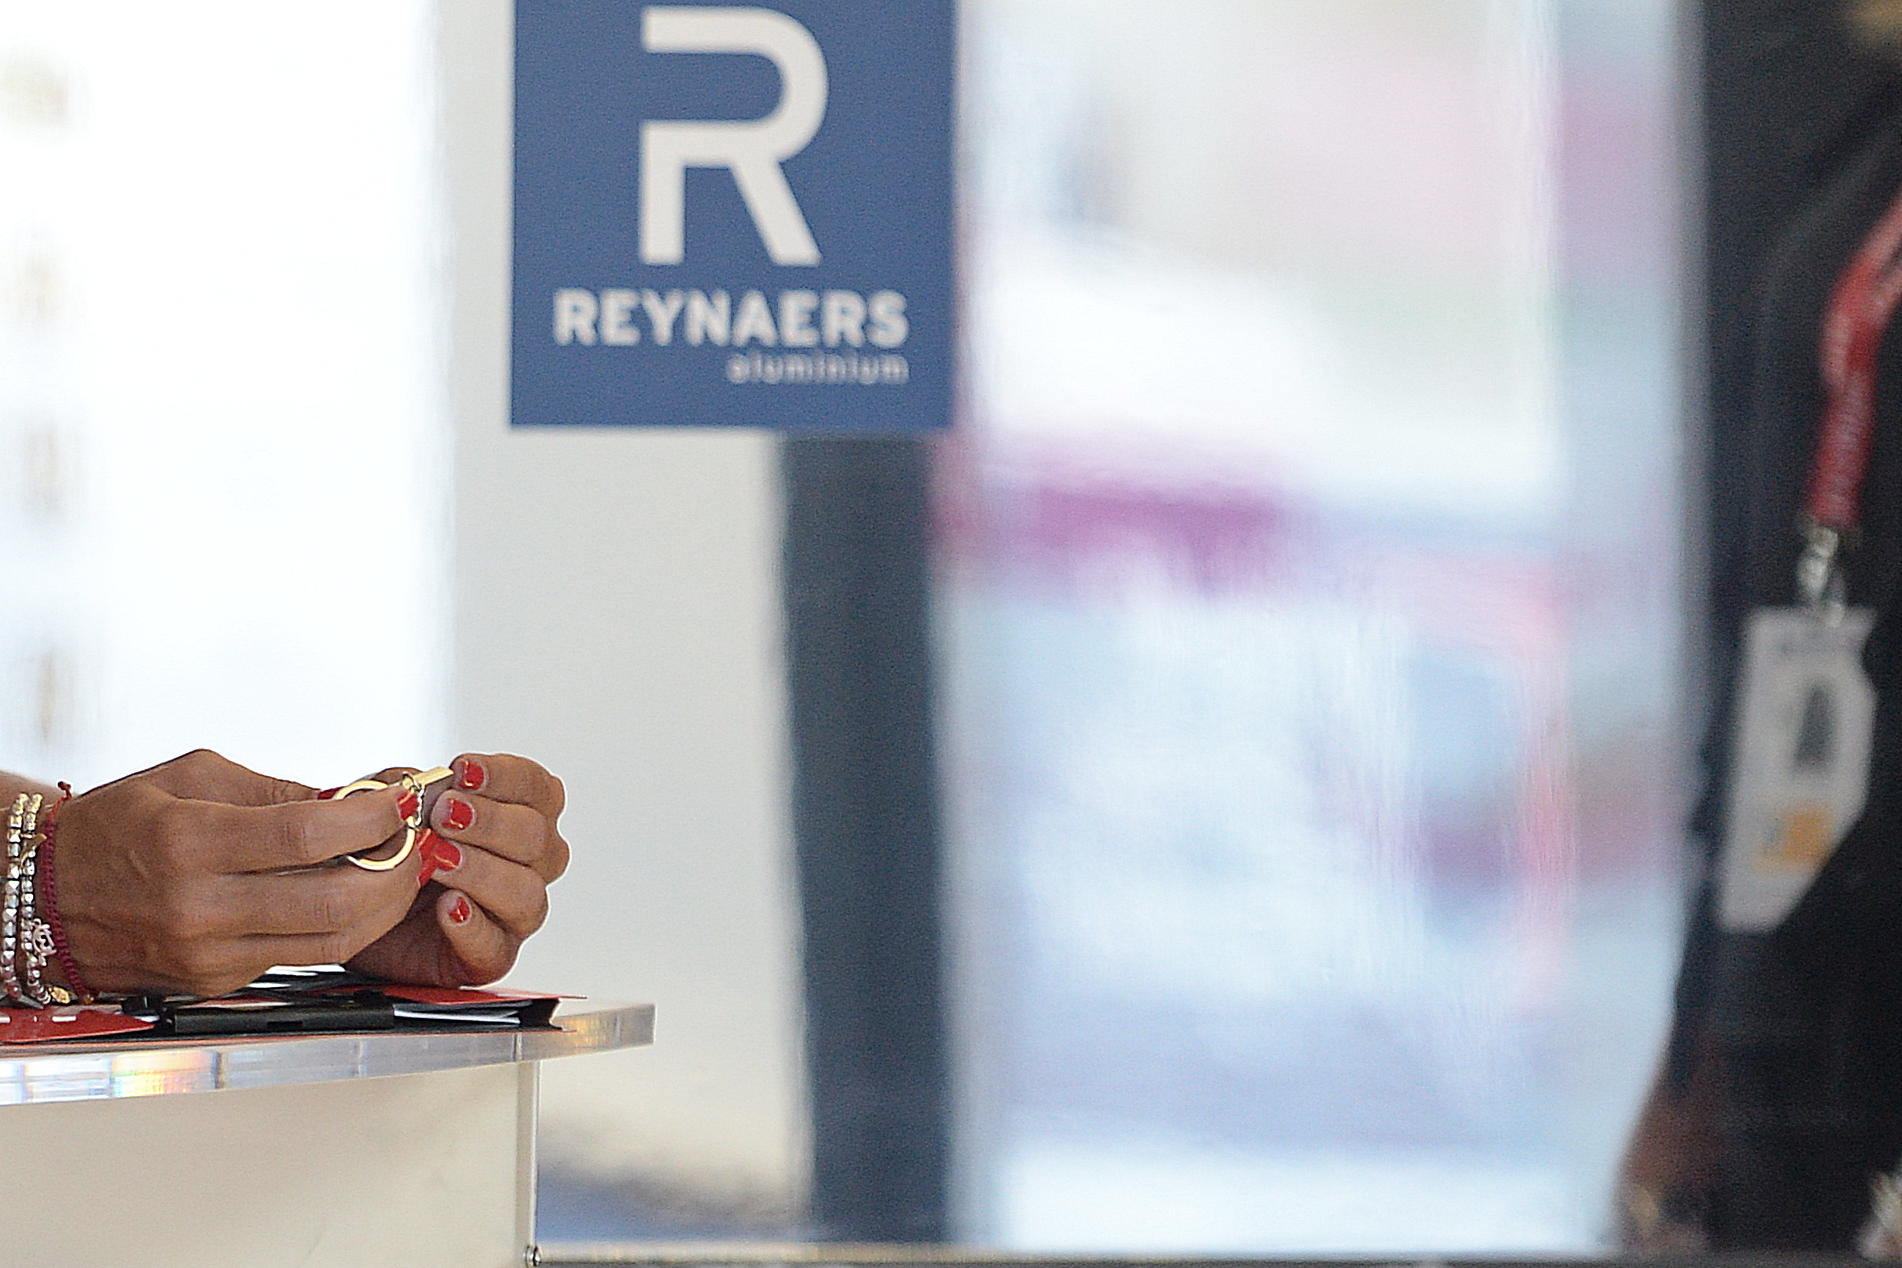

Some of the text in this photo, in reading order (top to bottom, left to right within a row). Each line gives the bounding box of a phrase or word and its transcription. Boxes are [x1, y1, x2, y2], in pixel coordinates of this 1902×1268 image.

[639, 4, 829, 266] R
[554, 288, 909, 348] REYNAERS
[727, 353, 909, 384] aluminium
